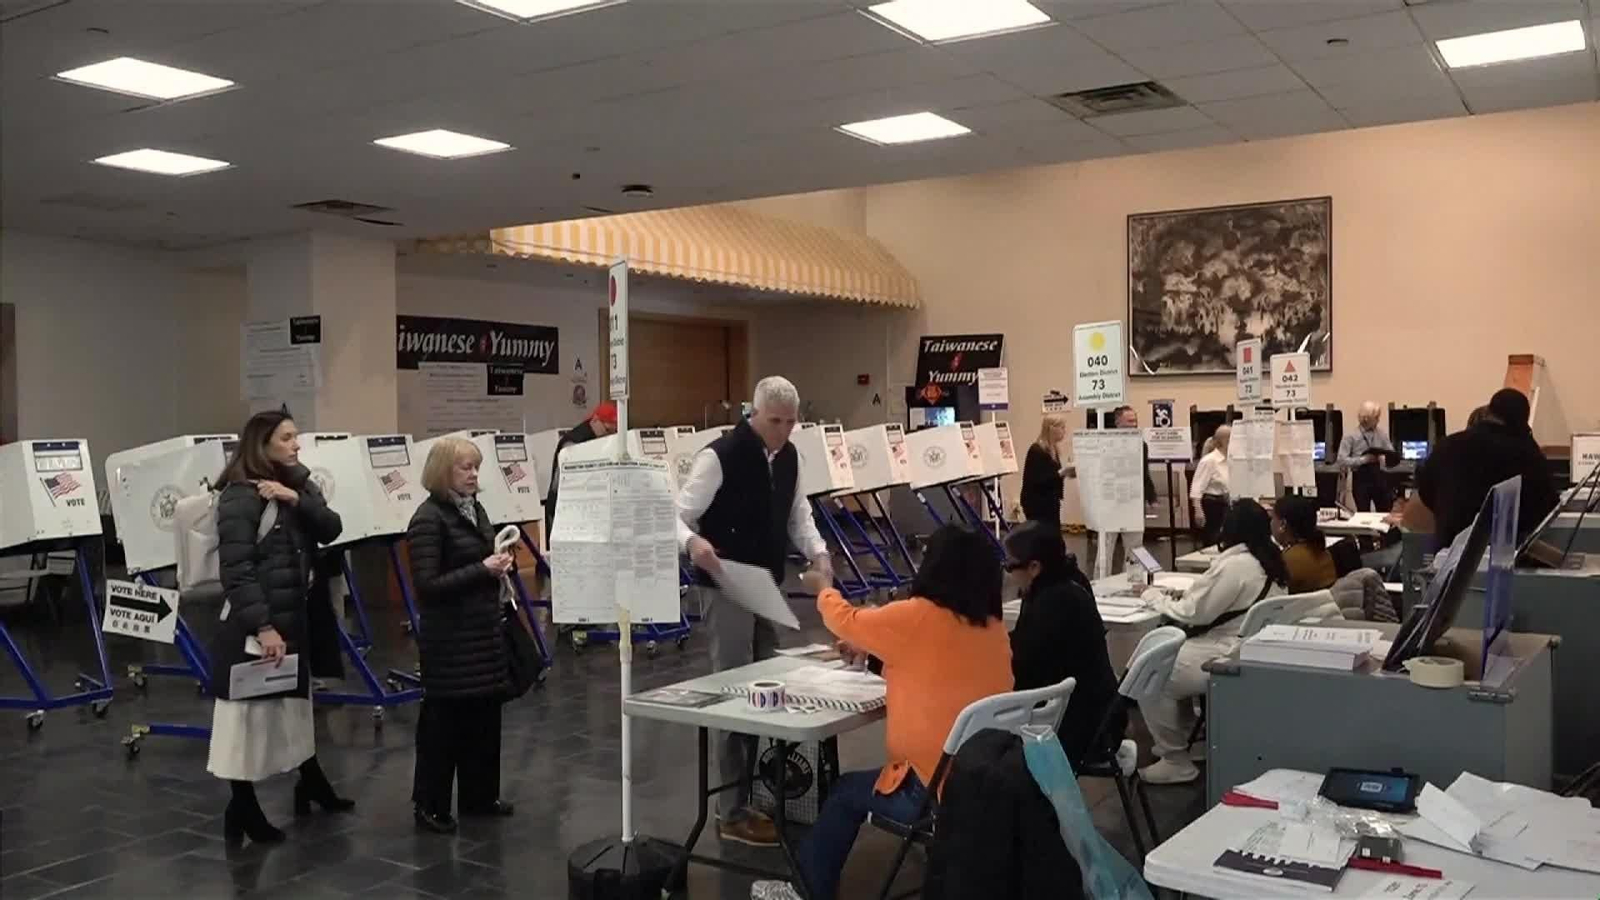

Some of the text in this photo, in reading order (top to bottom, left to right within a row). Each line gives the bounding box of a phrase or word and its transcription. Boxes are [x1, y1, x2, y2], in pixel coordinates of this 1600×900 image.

[398, 324, 554, 366] iwanese Yummy
[924, 340, 998, 353] Taiwanese
[1087, 355, 1108, 367] 040
[928, 370, 979, 386] Yummy
[1281, 374, 1299, 383] 042
[1091, 379, 1106, 390] 73
[872, 392, 881, 405] A
[66, 498, 85, 506] VOTE
[110, 584, 157, 600] VOTE HERE
[109, 608, 131, 619] VOTE
